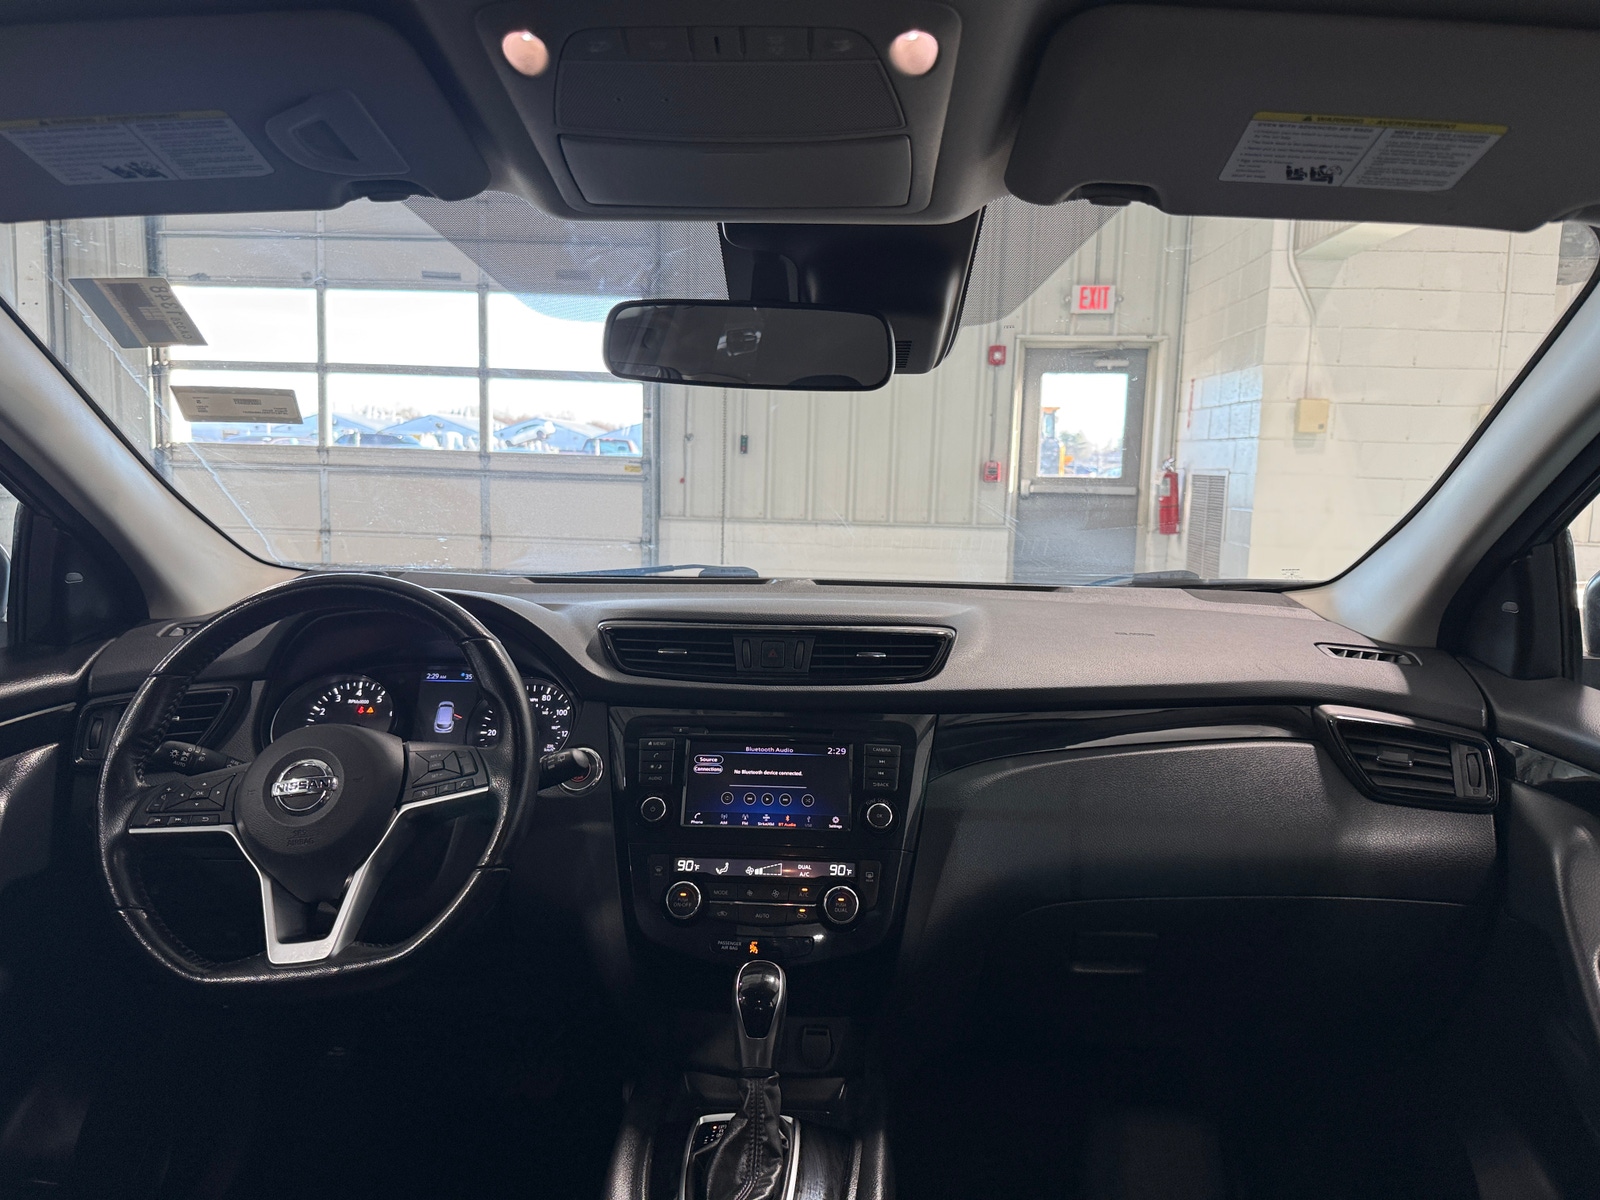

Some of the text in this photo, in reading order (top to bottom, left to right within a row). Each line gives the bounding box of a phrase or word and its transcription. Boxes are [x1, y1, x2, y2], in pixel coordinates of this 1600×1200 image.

[1079, 286, 1110, 310] EXIT
[355, 689, 363, 697] 4
[335, 694, 342, 703] 3
[376, 695, 383, 703] 5
[541, 694, 552, 702] 80
[319, 707, 326, 716] 2
[487, 729, 497, 737] 20
[827, 747, 847, 755] 2:29
[275, 779, 331, 793] NISSAN
